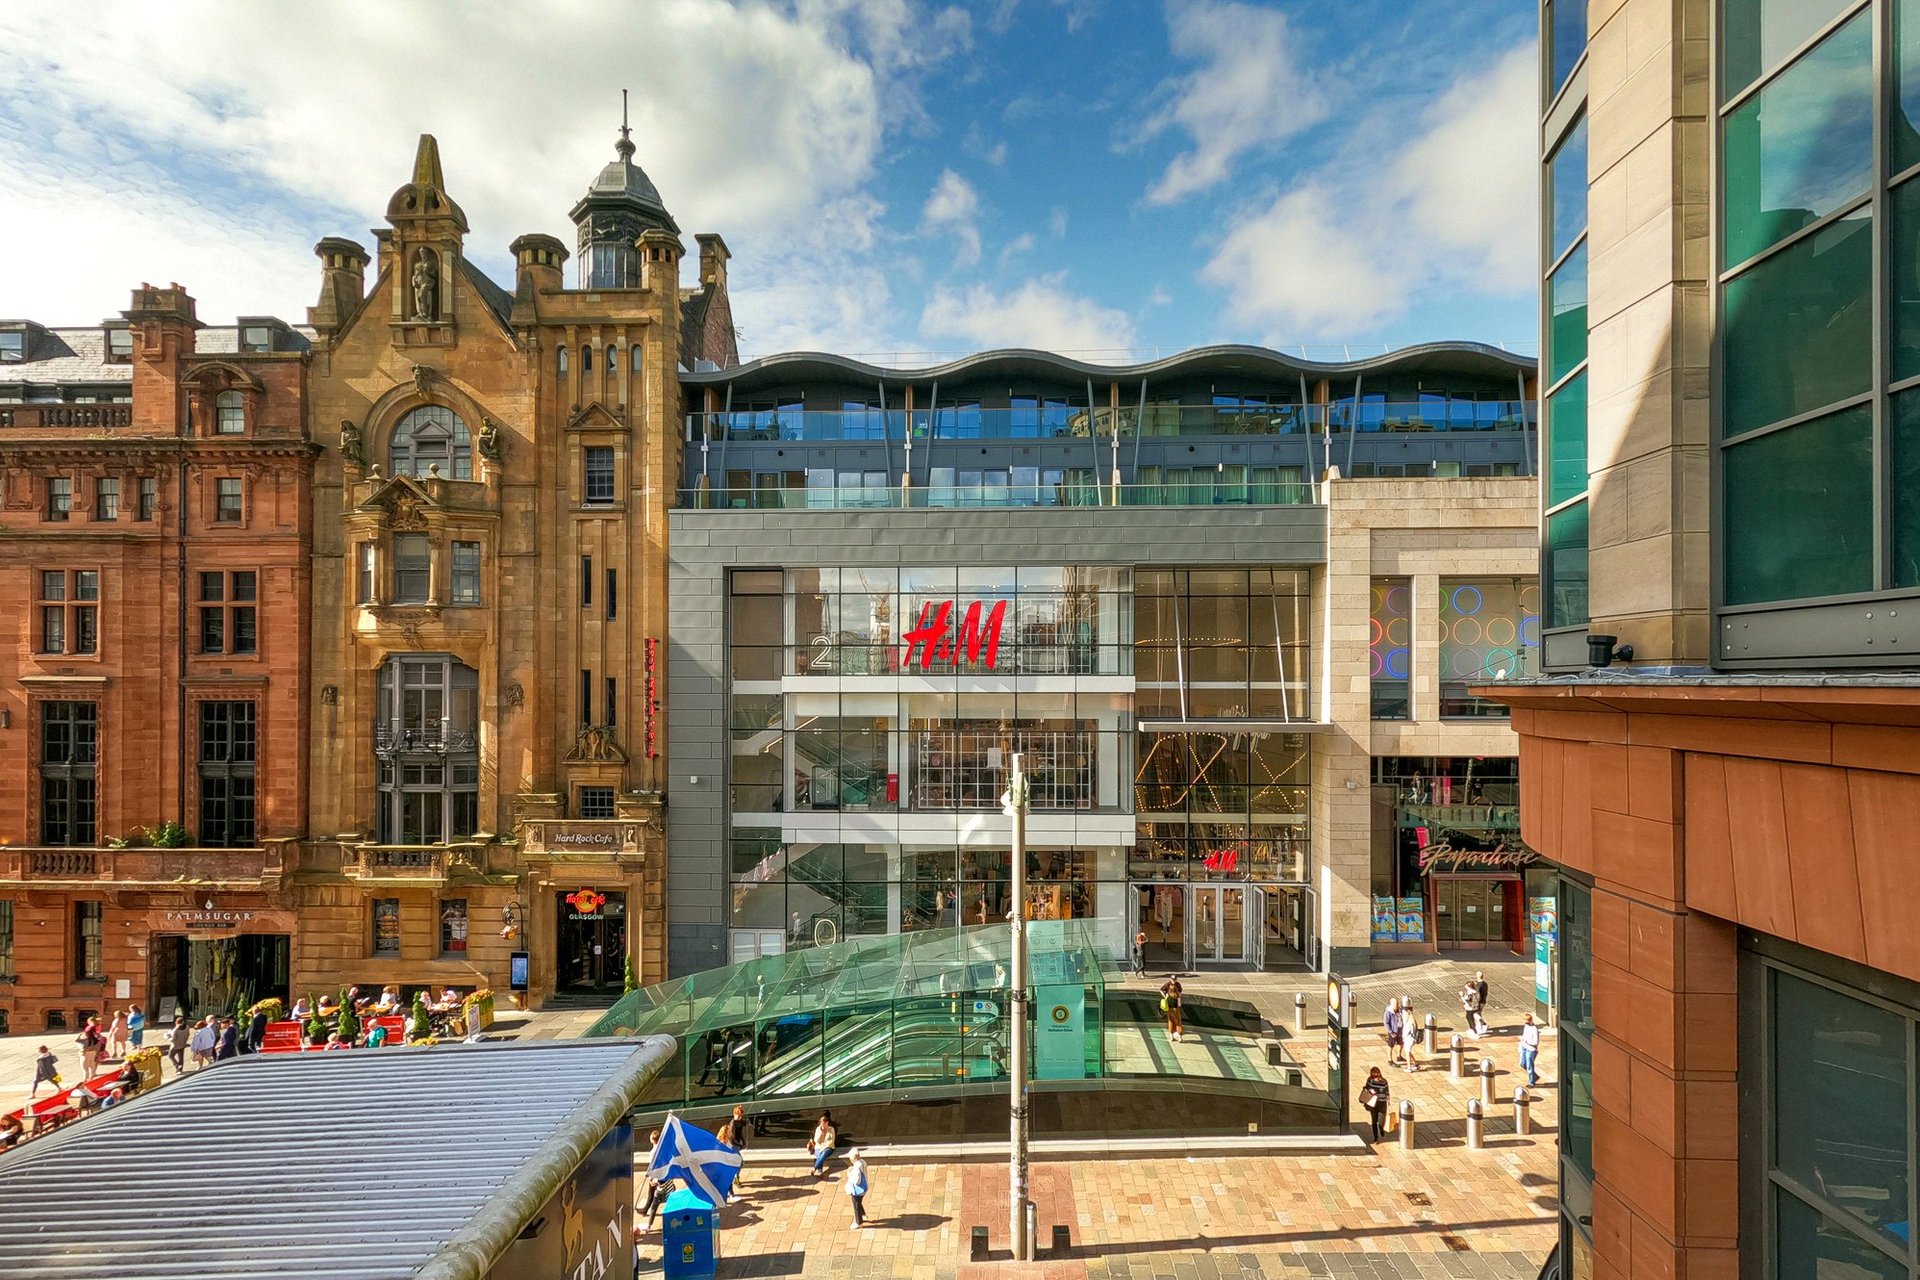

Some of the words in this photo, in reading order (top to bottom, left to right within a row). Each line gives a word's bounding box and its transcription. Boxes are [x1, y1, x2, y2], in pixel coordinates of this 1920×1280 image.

[902, 600, 1007, 671] H&M
[811, 636, 832, 667] 2
[555, 834, 575, 843] Hard
[576, 834, 594, 844] Rock
[594, 834, 613, 844] Cafe
[1420, 841, 1539, 876] Paperchase
[167, 912, 250, 920] PALMSUGAR
